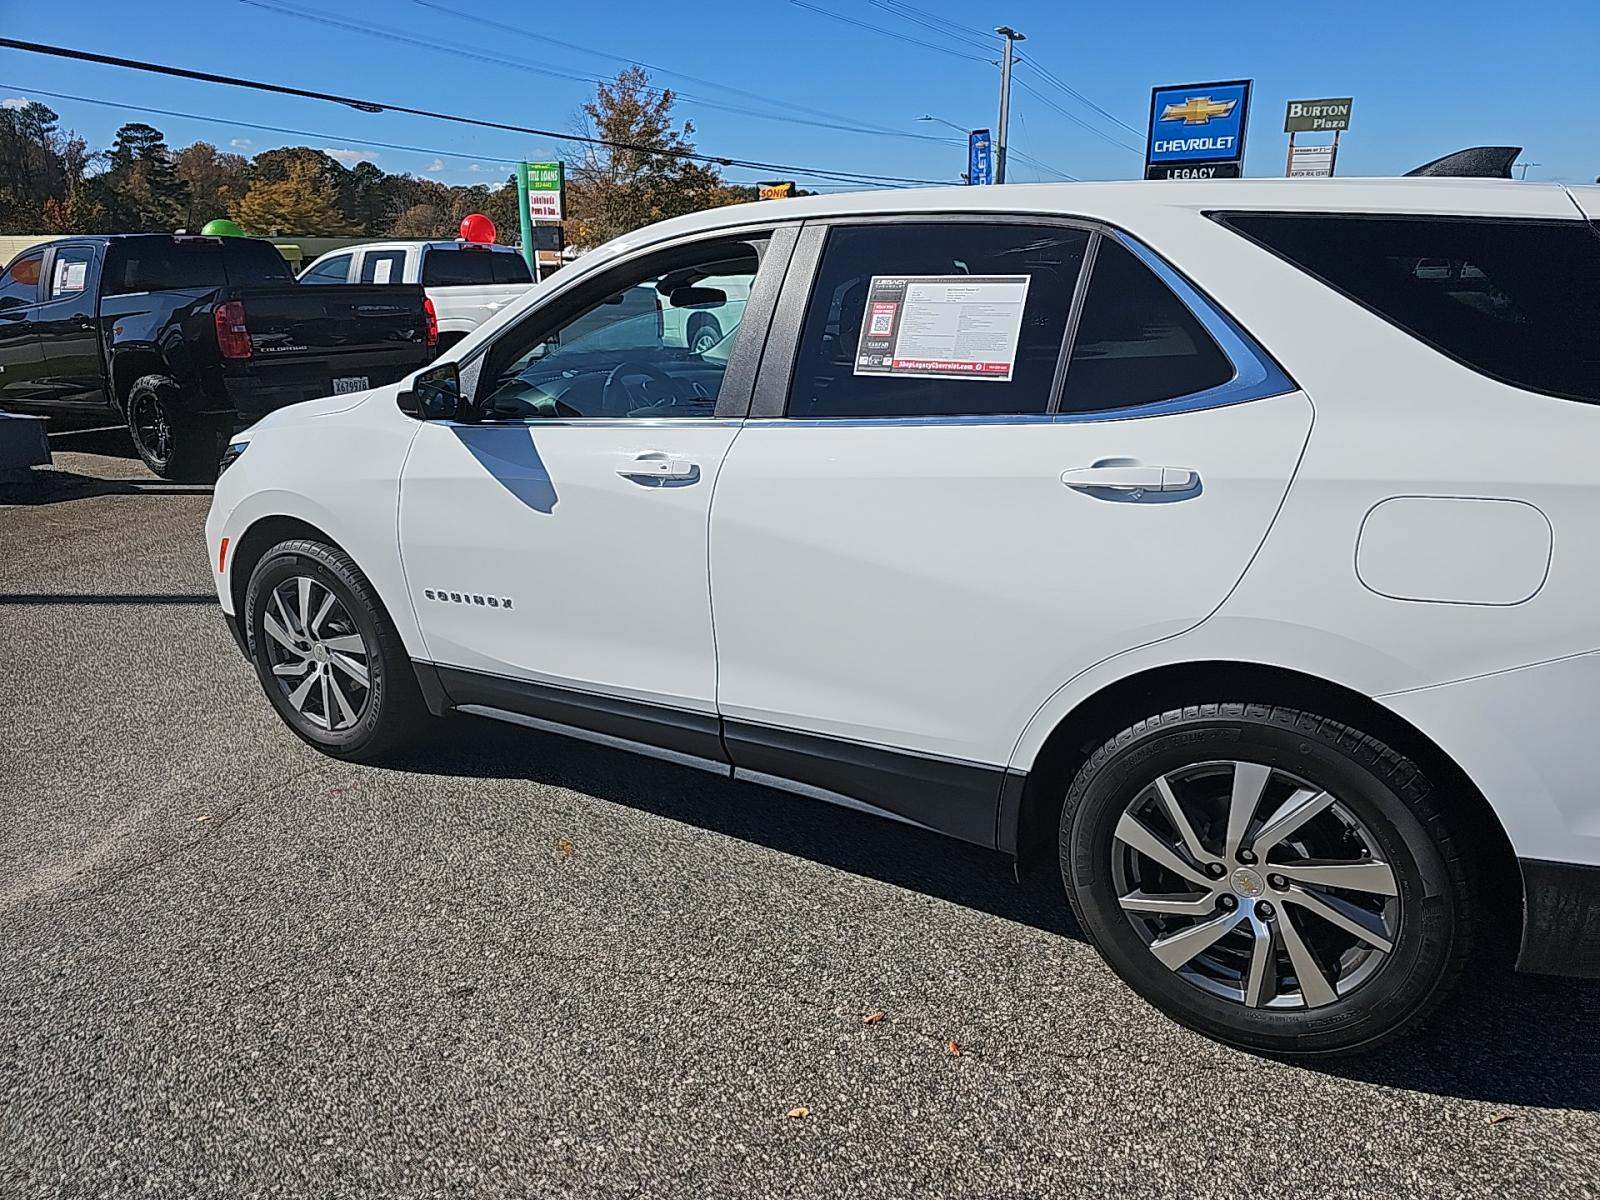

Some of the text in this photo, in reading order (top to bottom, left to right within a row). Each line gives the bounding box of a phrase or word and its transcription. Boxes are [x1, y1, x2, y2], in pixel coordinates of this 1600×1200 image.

[1289, 103, 1349, 119] BURTON
[1313, 117, 1346, 129] Plaza
[1154, 135, 1235, 153] CHEVROLET
[541, 170, 558, 181] LOANS
[1166, 167, 1216, 179] LEGACY
[761, 188, 789, 198] SONIC
[424, 589, 514, 610] EQUINOX
